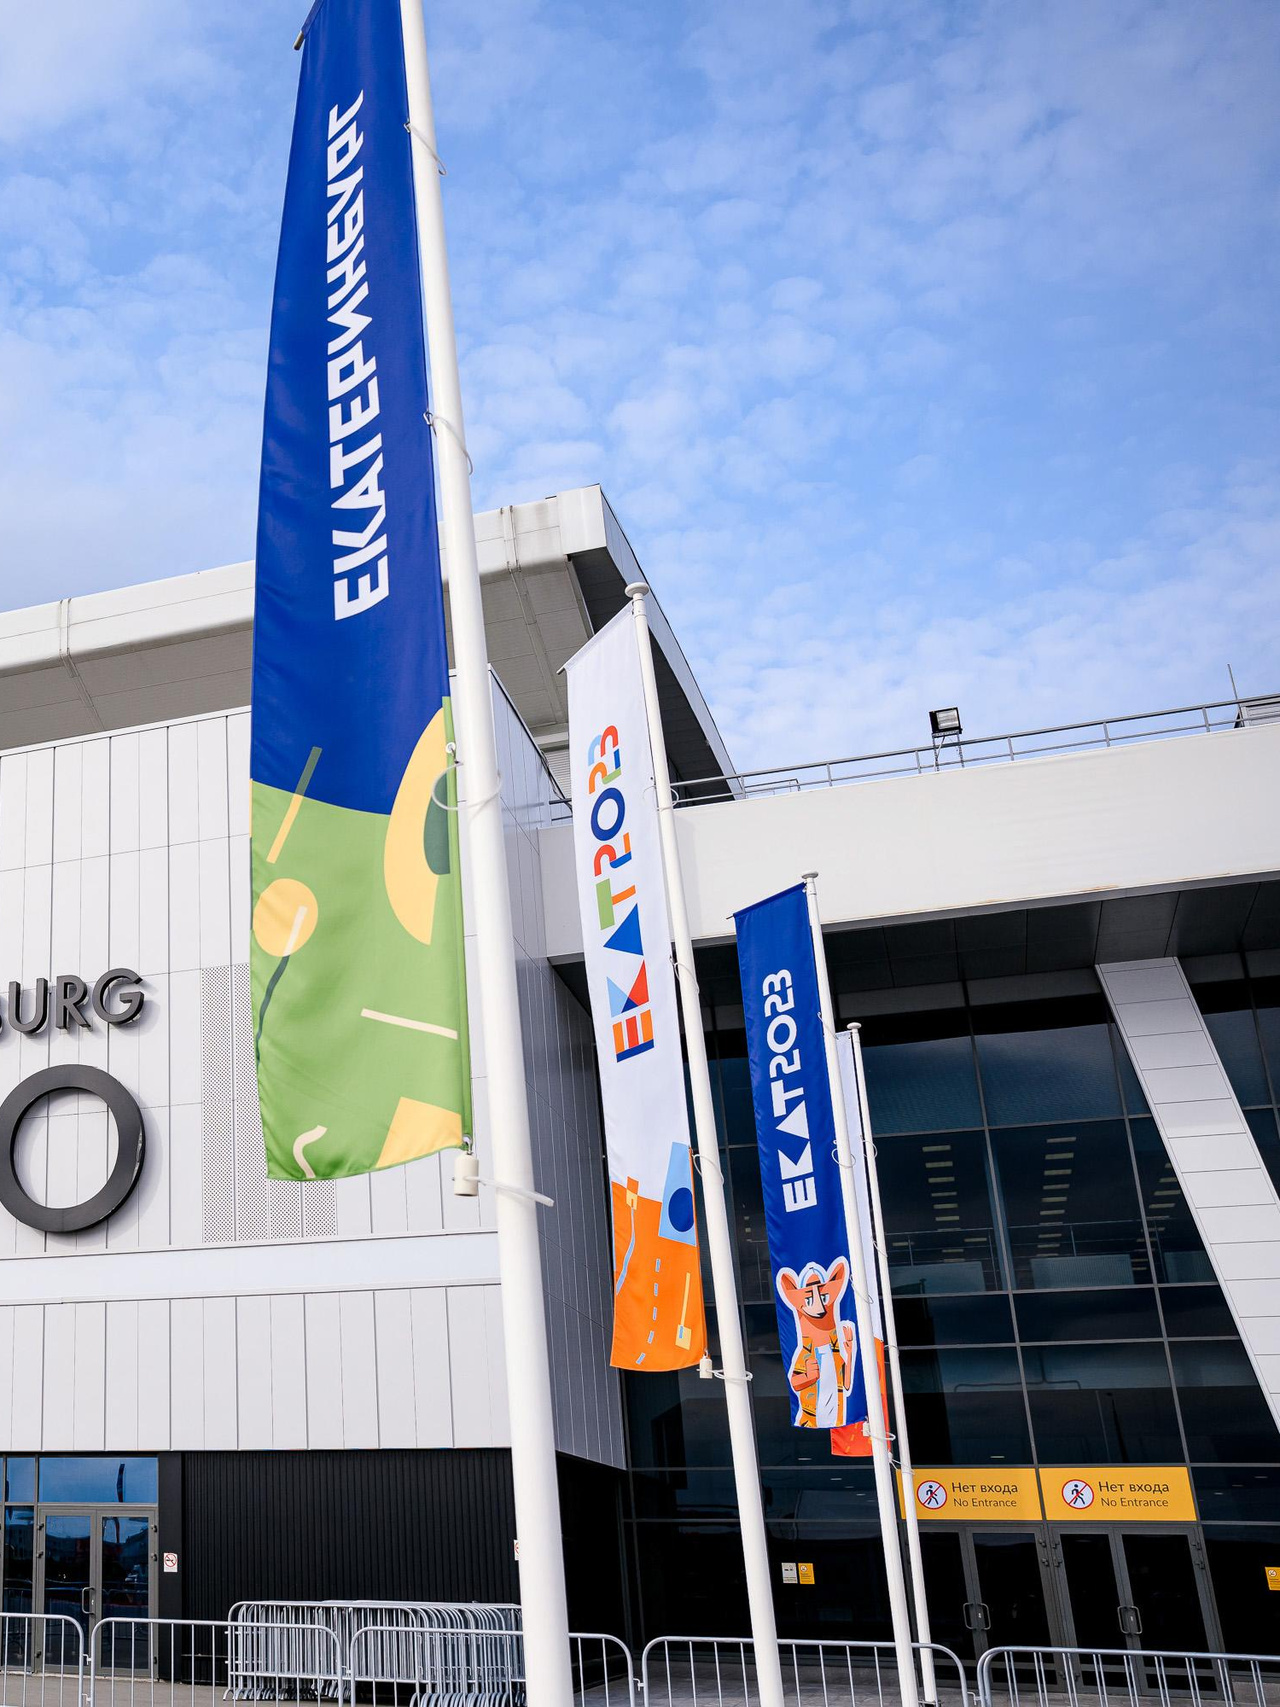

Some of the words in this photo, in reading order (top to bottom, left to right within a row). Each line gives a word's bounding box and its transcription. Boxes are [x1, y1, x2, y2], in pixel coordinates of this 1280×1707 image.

[326, 89, 390, 621] ЕКАТЕРИНБУРГ
[951, 1482, 976, 1493] Нет
[980, 1484, 1018, 1495] входа
[1098, 1481, 1125, 1492] Нет
[1129, 1483, 1170, 1494] входа
[953, 1498, 969, 1507] No
[971, 1498, 1017, 1507] Entrance
[1101, 1498, 1117, 1507] No
[1120, 1497, 1169, 1507] Entrance
